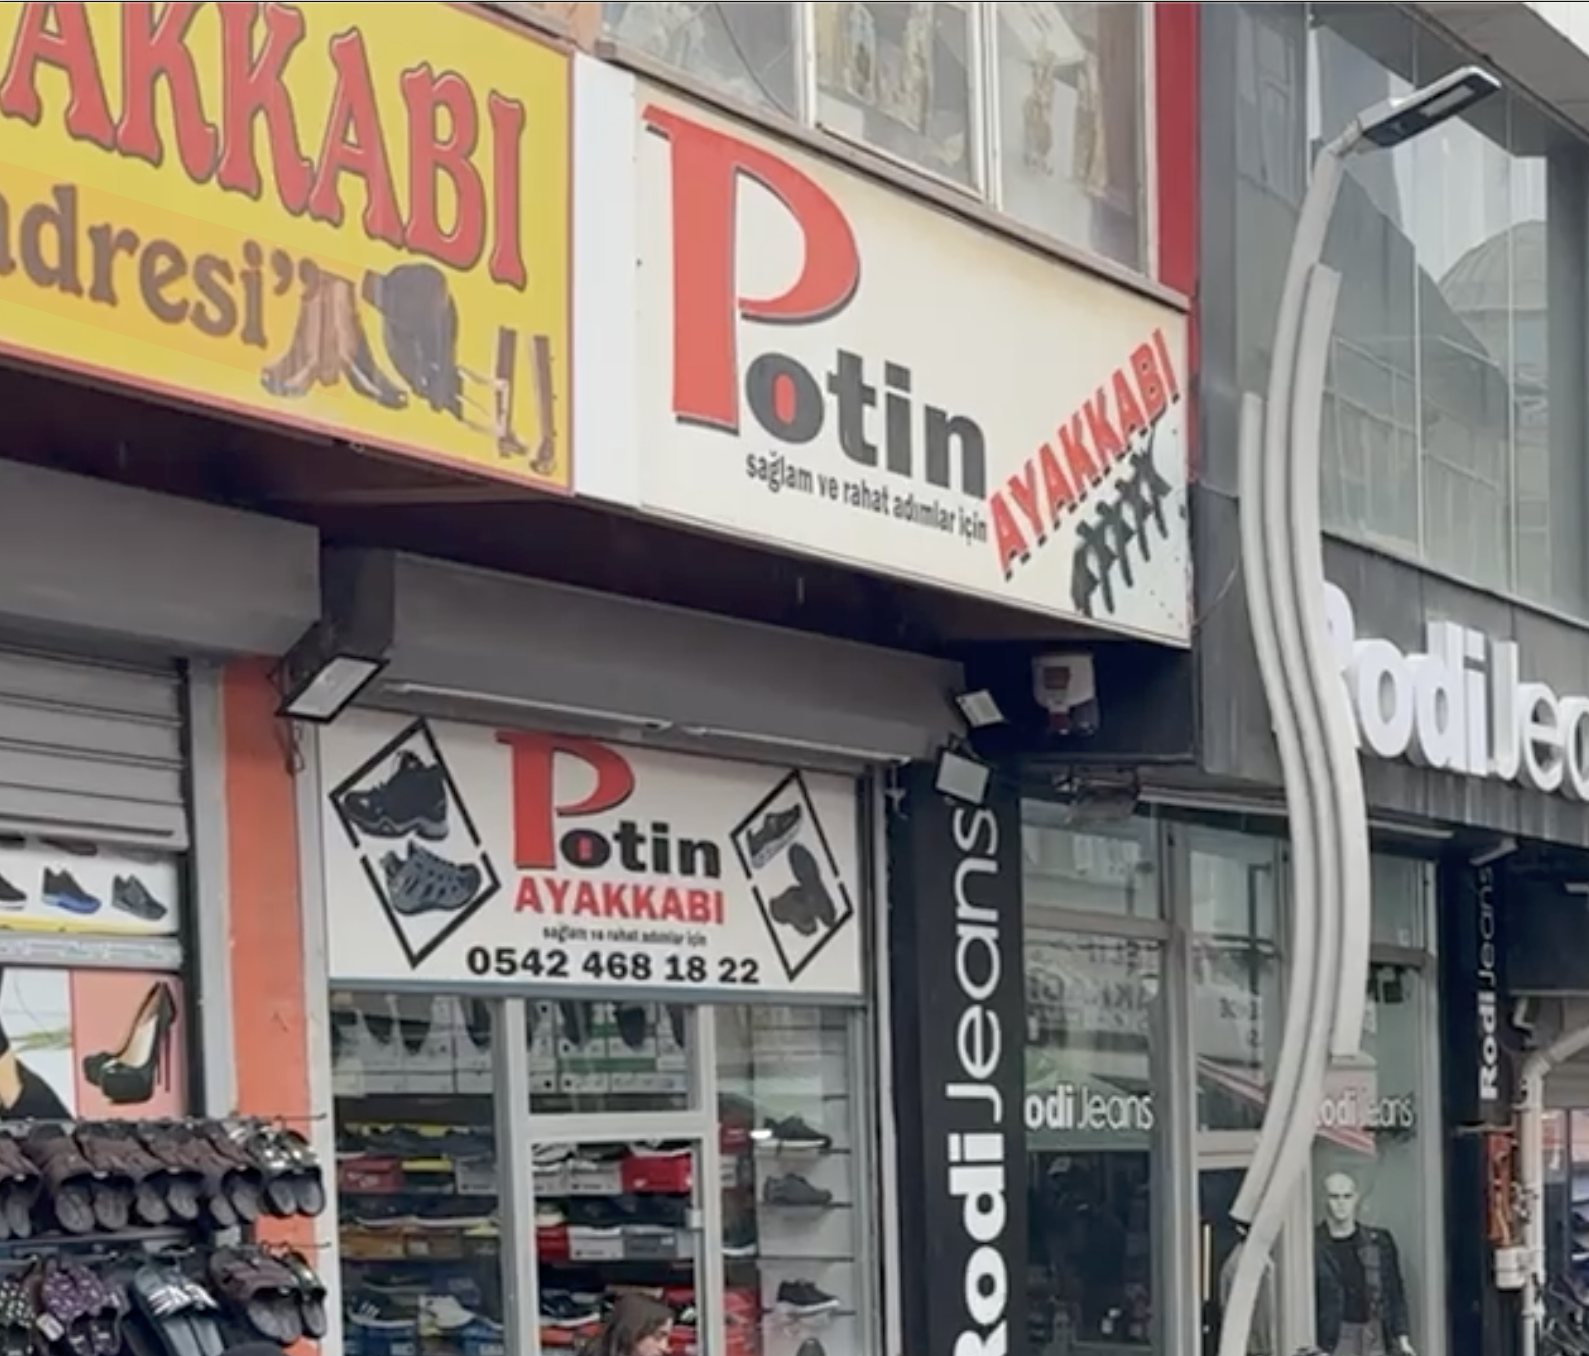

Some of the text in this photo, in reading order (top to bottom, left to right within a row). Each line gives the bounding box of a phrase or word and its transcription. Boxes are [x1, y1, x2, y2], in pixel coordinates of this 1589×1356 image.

[641, 104, 987, 499] Potin
[745, 450, 988, 545] sağlam ve rahat adımlar için
[987, 327, 1179, 578] AYAKKABI
[496, 729, 723, 879] Potin
[513, 874, 725, 925] AYAKKABI
[466, 946, 759, 984] 0542 468 18 22
